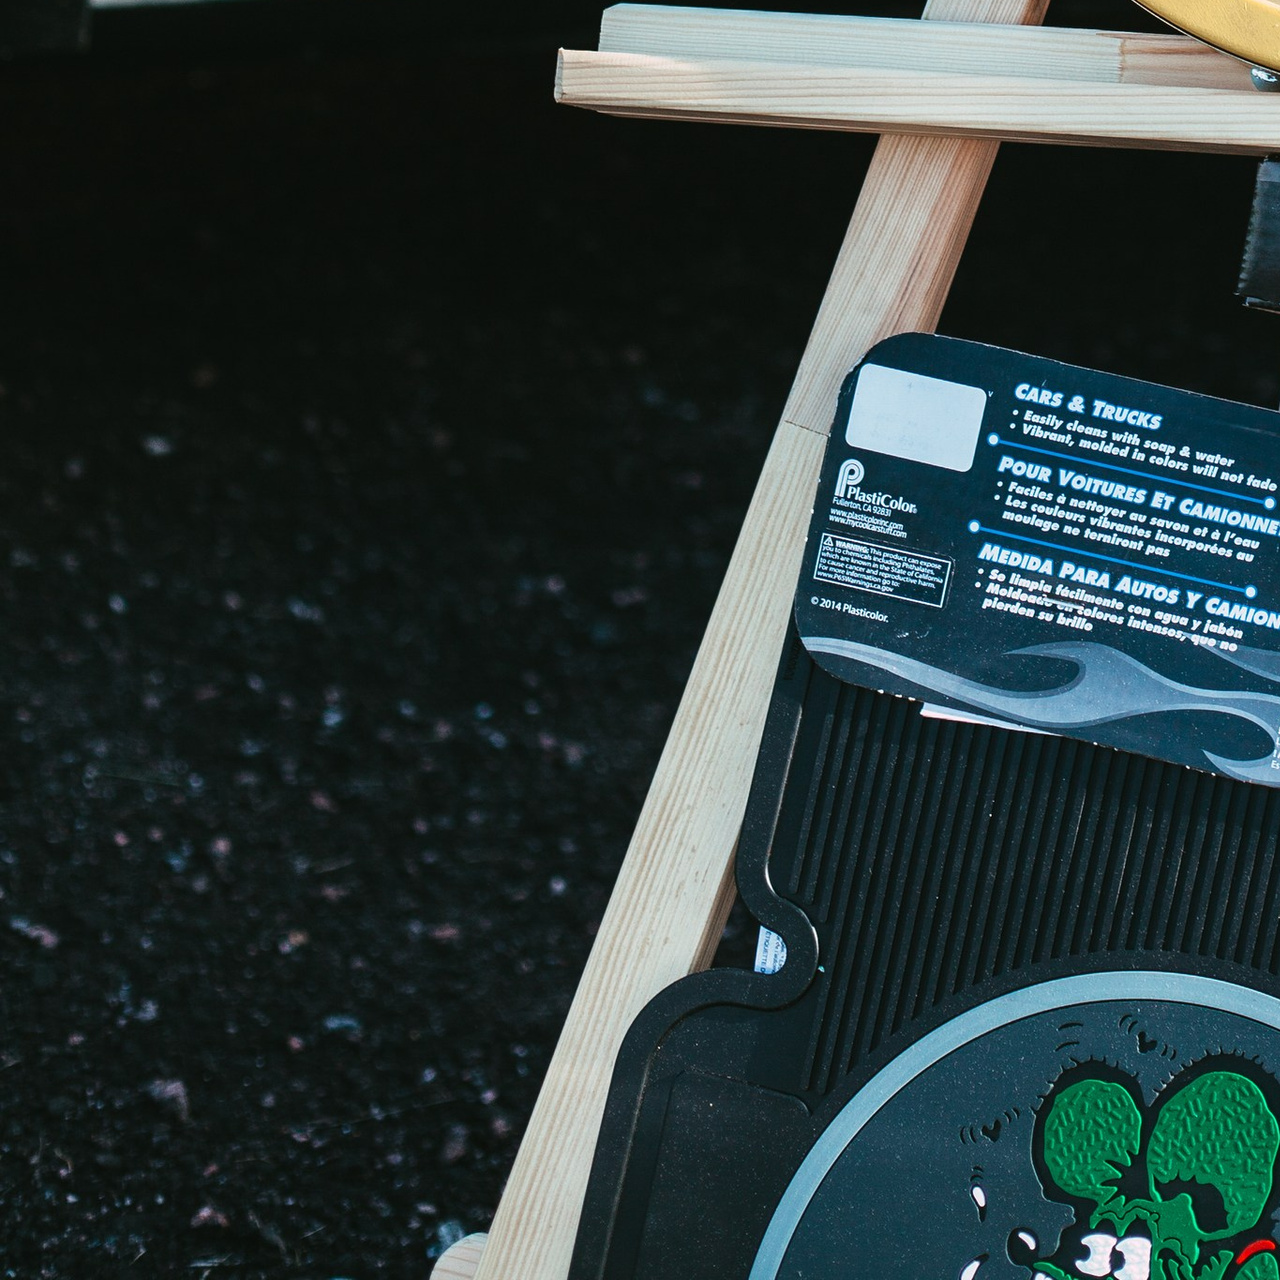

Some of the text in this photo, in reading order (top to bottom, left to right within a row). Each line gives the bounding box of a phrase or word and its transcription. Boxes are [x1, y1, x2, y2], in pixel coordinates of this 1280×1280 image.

[1015, 383, 1162, 430] CARS & TRUCKS
[1023, 410, 1235, 468] Easily cleans with soap & water
[1023, 423, 1278, 492] Vibrant, molded in colors will not fade
[832, 496, 892, 517] Fullerton, CA 92831
[998, 456, 1052, 483] POUR
[1058, 468, 1148, 505] VOITURES
[1151, 491, 1175, 510] ET
[1002, 511, 1171, 557] moulage ne terniront pas
[1005, 495, 1255, 563] Les couleurs vibrantes incorporées au
[1008, 481, 1054, 501] Faciles
[1056, 493, 1067, 505] à
[1069, 498, 1127, 518] nettoyer
[1129, 512, 1147, 523] au
[1149, 517, 1190, 533] savon
[1193, 527, 1208, 537] et
[1210, 529, 1221, 541] à
[978, 544, 1052, 575] MEDIDA
[1059, 562, 1110, 589] PARA
[1114, 576, 1180, 604] AUTOS
[1186, 591, 1204, 609] Y
[819, 598, 889, 623] 2014 Plasticolor.
[981, 597, 1093, 632] pierden su brillo
[988, 569, 1243, 639] Se limpia fácilmente con agua y jabón
[1076, 604, 1125, 625] colores
[1127, 615, 1188, 642] intensos,
[1190, 634, 1217, 647] que
[1219, 641, 1238, 652] no
[1271, 760, 1280, 769] Es
